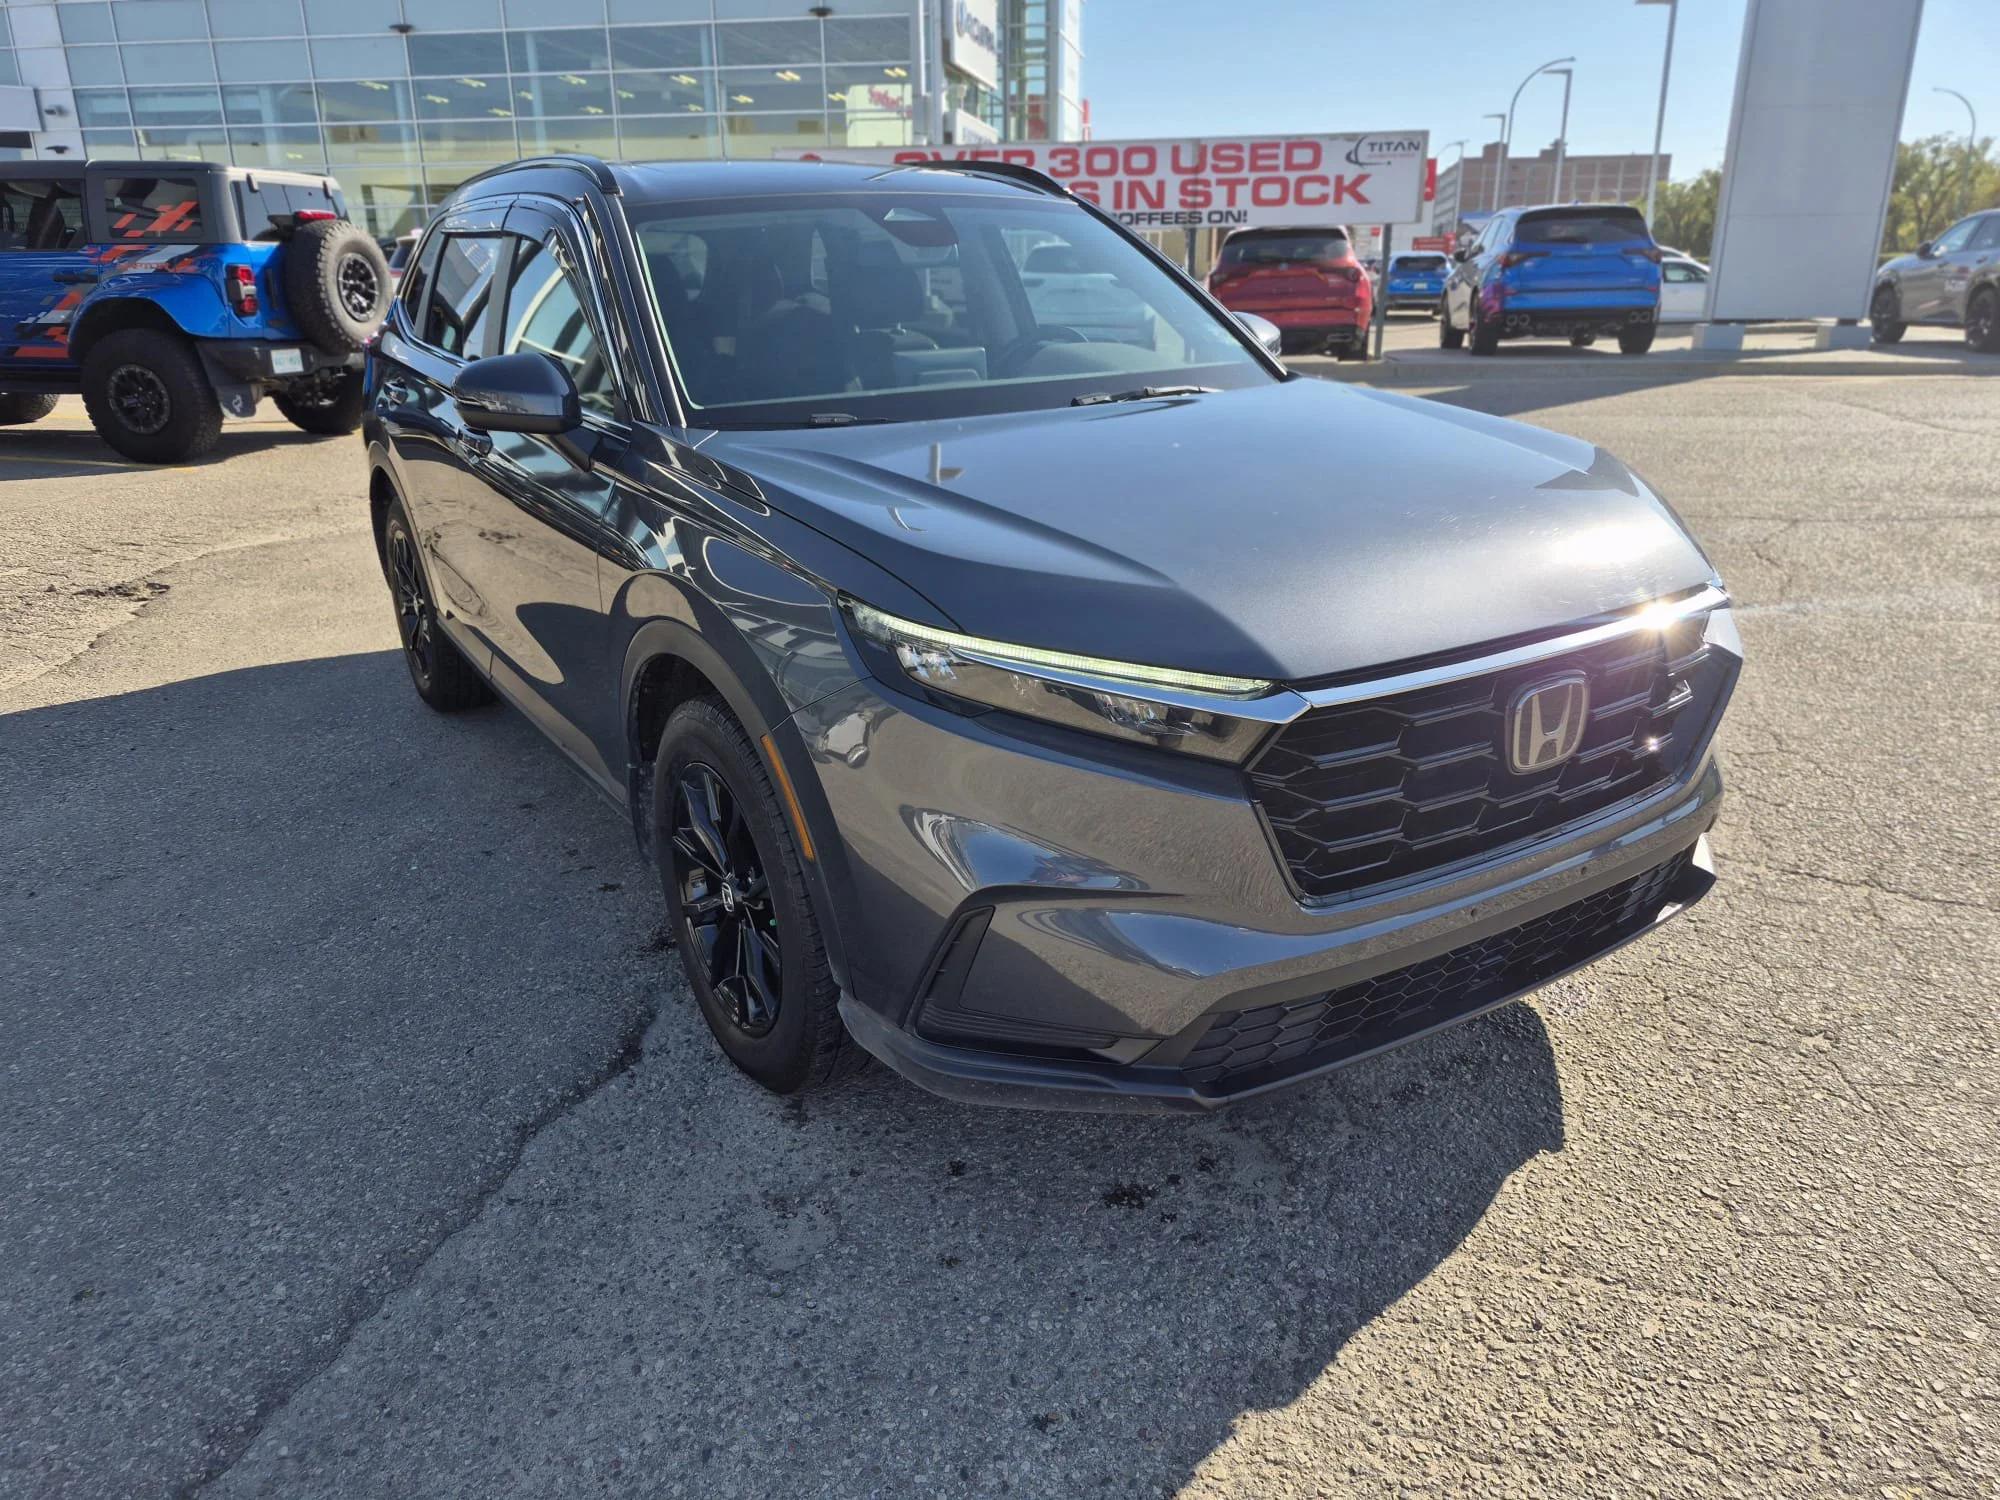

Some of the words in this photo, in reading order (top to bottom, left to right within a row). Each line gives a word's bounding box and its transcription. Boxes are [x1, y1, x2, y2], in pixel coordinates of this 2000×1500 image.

[1048, 147, 1157, 179] 300
[1170, 141, 1323, 175] USED
[1367, 141, 1421, 152] TITAN
[1112, 179, 1166, 210] IN
[1178, 173, 1372, 209] STOCK
[1113, 211, 1203, 226] OFFEES
[1207, 209, 1248, 225] ON!
